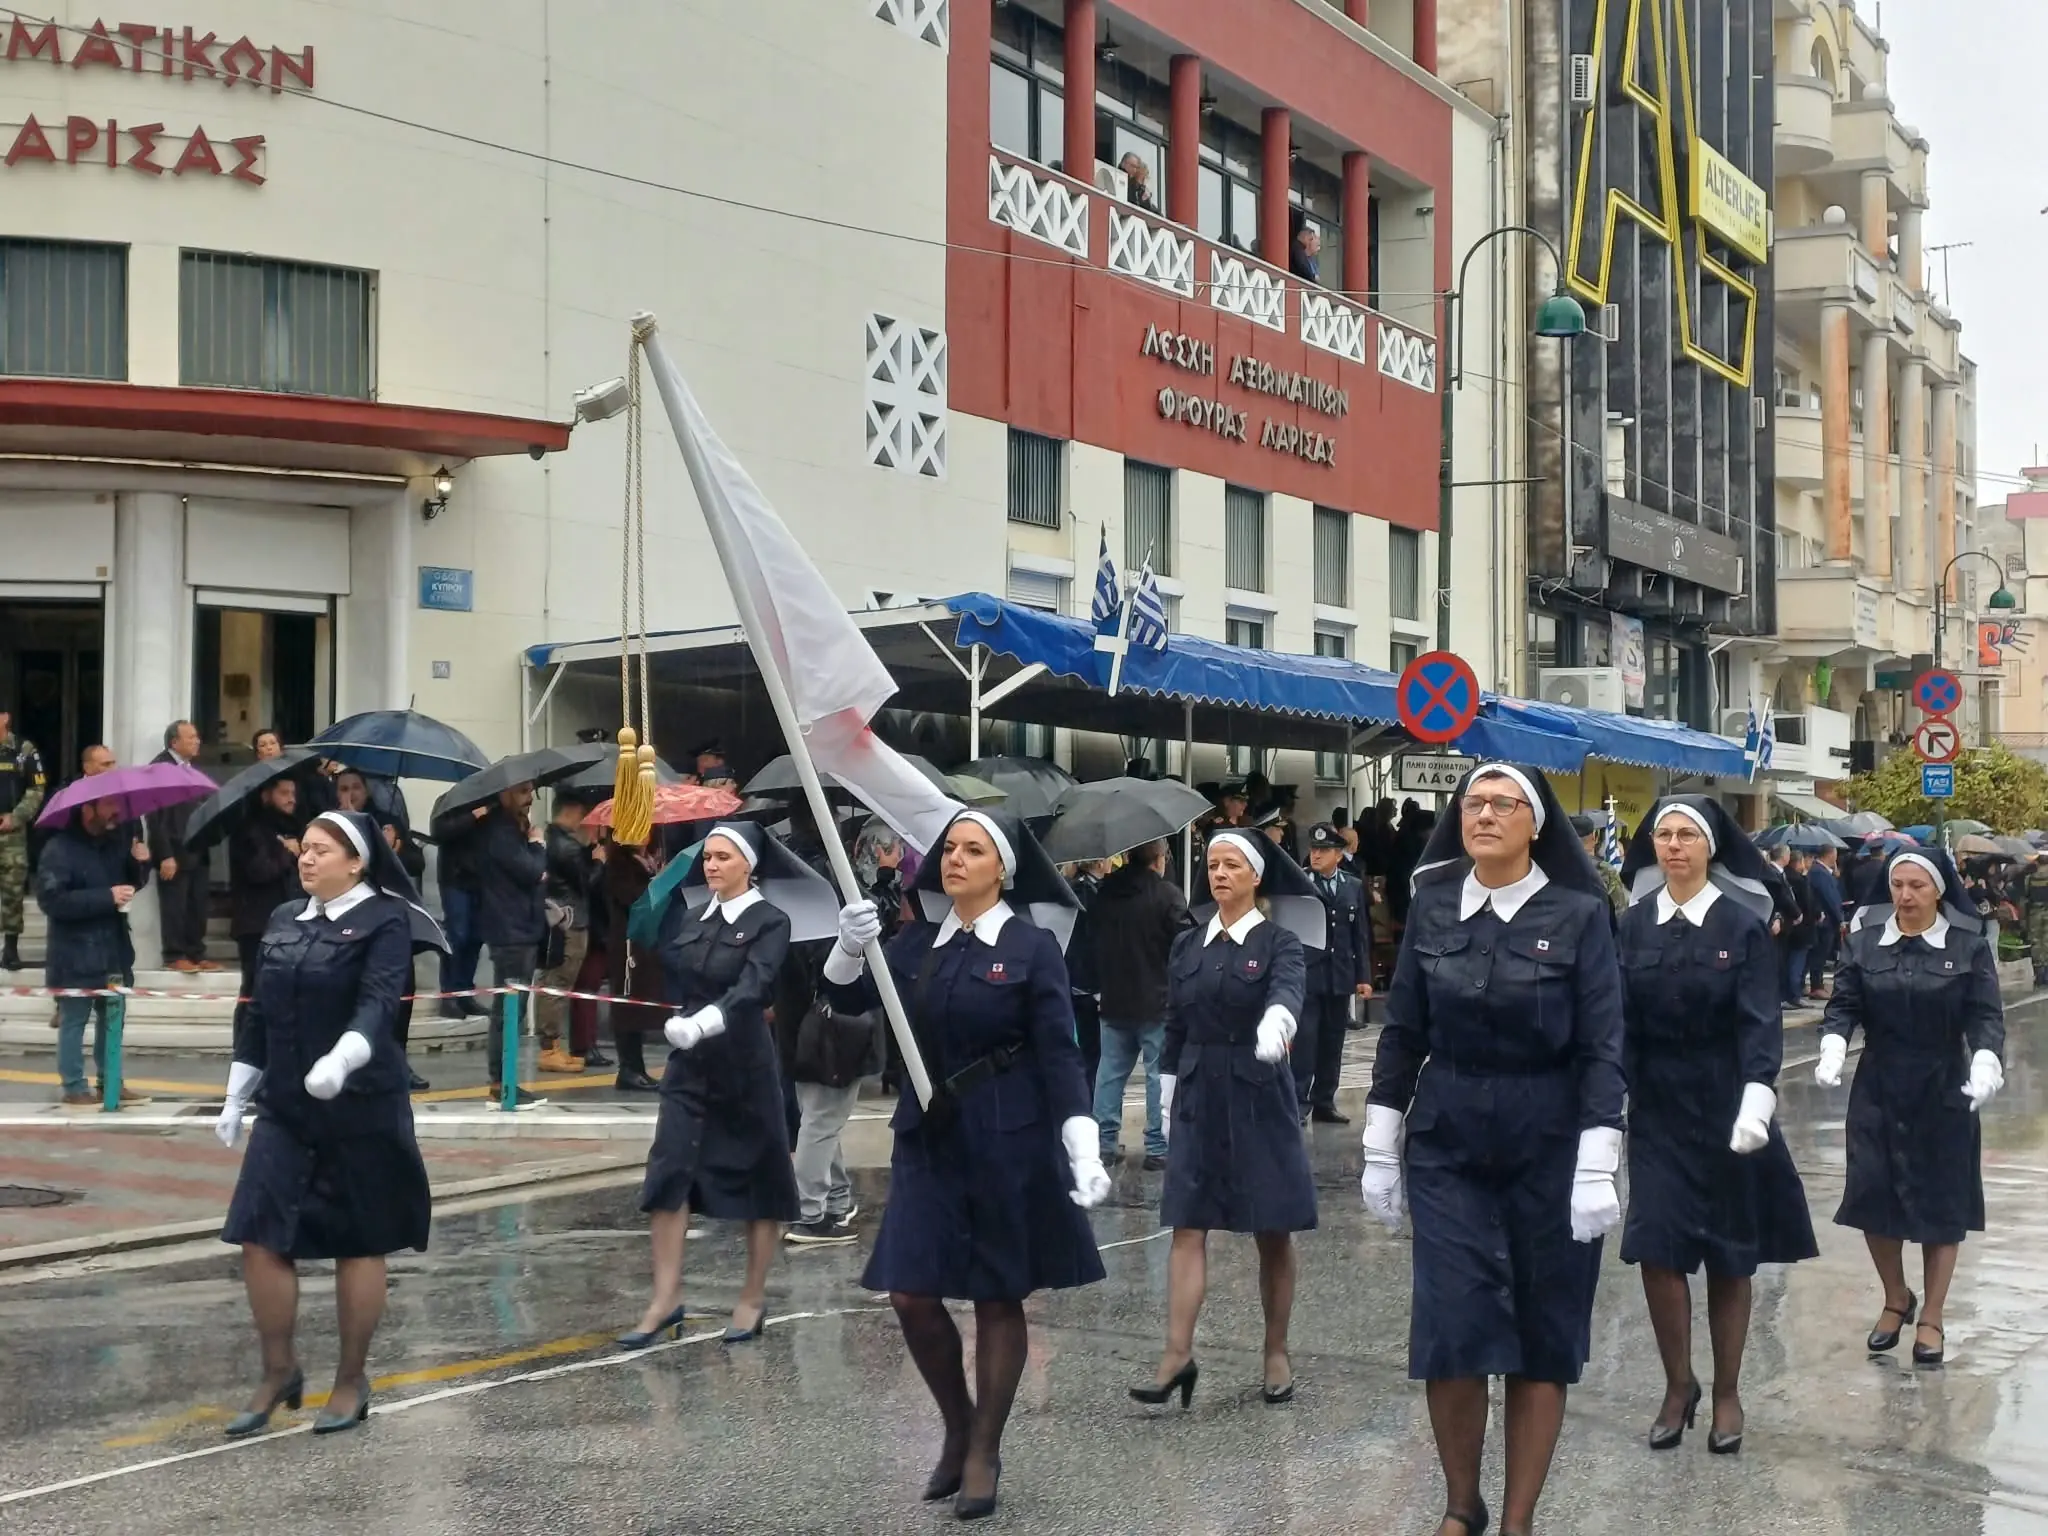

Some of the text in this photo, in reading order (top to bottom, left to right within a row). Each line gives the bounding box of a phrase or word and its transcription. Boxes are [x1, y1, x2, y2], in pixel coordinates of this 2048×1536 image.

[0, 15, 314, 94] ΜΑΤΙΚΩΝ
[4, 112, 267, 186] ΑΡΙΣΑΣ
[1705, 158, 1761, 229] ALTERLIFE
[1141, 321, 1349, 419] ΛΕΣΧΗ ΑΞΙΩΜΑΤΙΚΩΝ
[1156, 386, 1336, 469] ΦΡΟΥΡΑΣ ΛΑΡΙΣΑΣ
